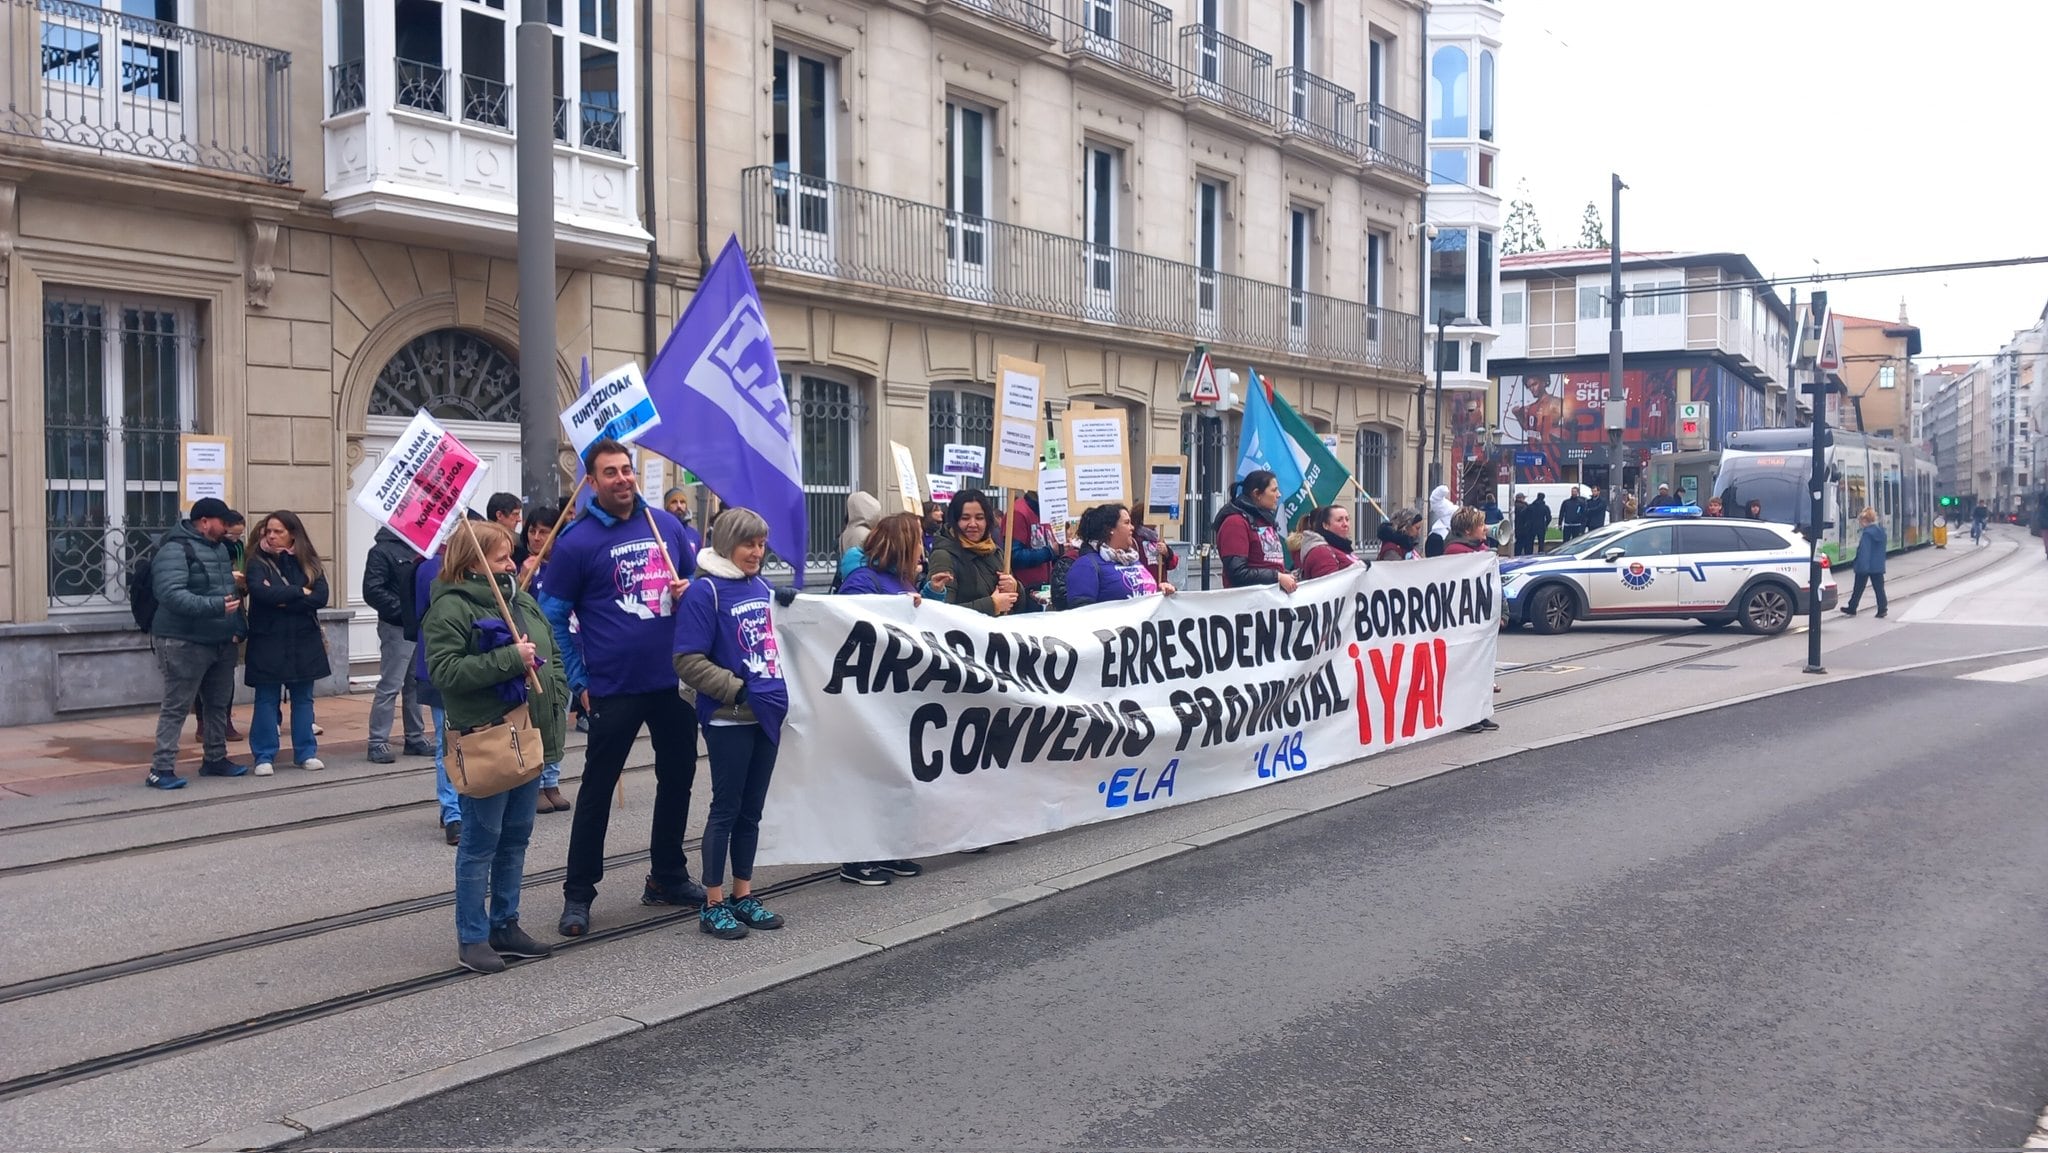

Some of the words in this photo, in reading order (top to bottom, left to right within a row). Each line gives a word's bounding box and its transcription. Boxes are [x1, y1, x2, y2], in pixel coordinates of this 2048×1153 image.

[715, 311, 791, 434] LA
[1576, 381, 1600, 390] THE
[572, 374, 632, 428] FUNTSEZKOAK
[594, 402, 622, 431] BAINA
[376, 459, 408, 500] ZAINTZA
[404, 428, 430, 460] LANAK
[383, 469, 414, 512] GUZTION
[412, 435, 442, 474] ARDURA,
[416, 467, 446, 505] PUBLIKO
[393, 477, 424, 518] ZAINTZA
[437, 486, 461, 516] ORAIN
[823, 620, 1078, 694] ARABAKO
[1093, 596, 1347, 688] ERRESIDENTZIAK
[1355, 573, 1492, 641] BORROKAN
[909, 699, 1155, 782] CONVENIO
[1169, 659, 1350, 751] PROVINCIAL
[1348, 638, 1447, 745] ¡YA!
